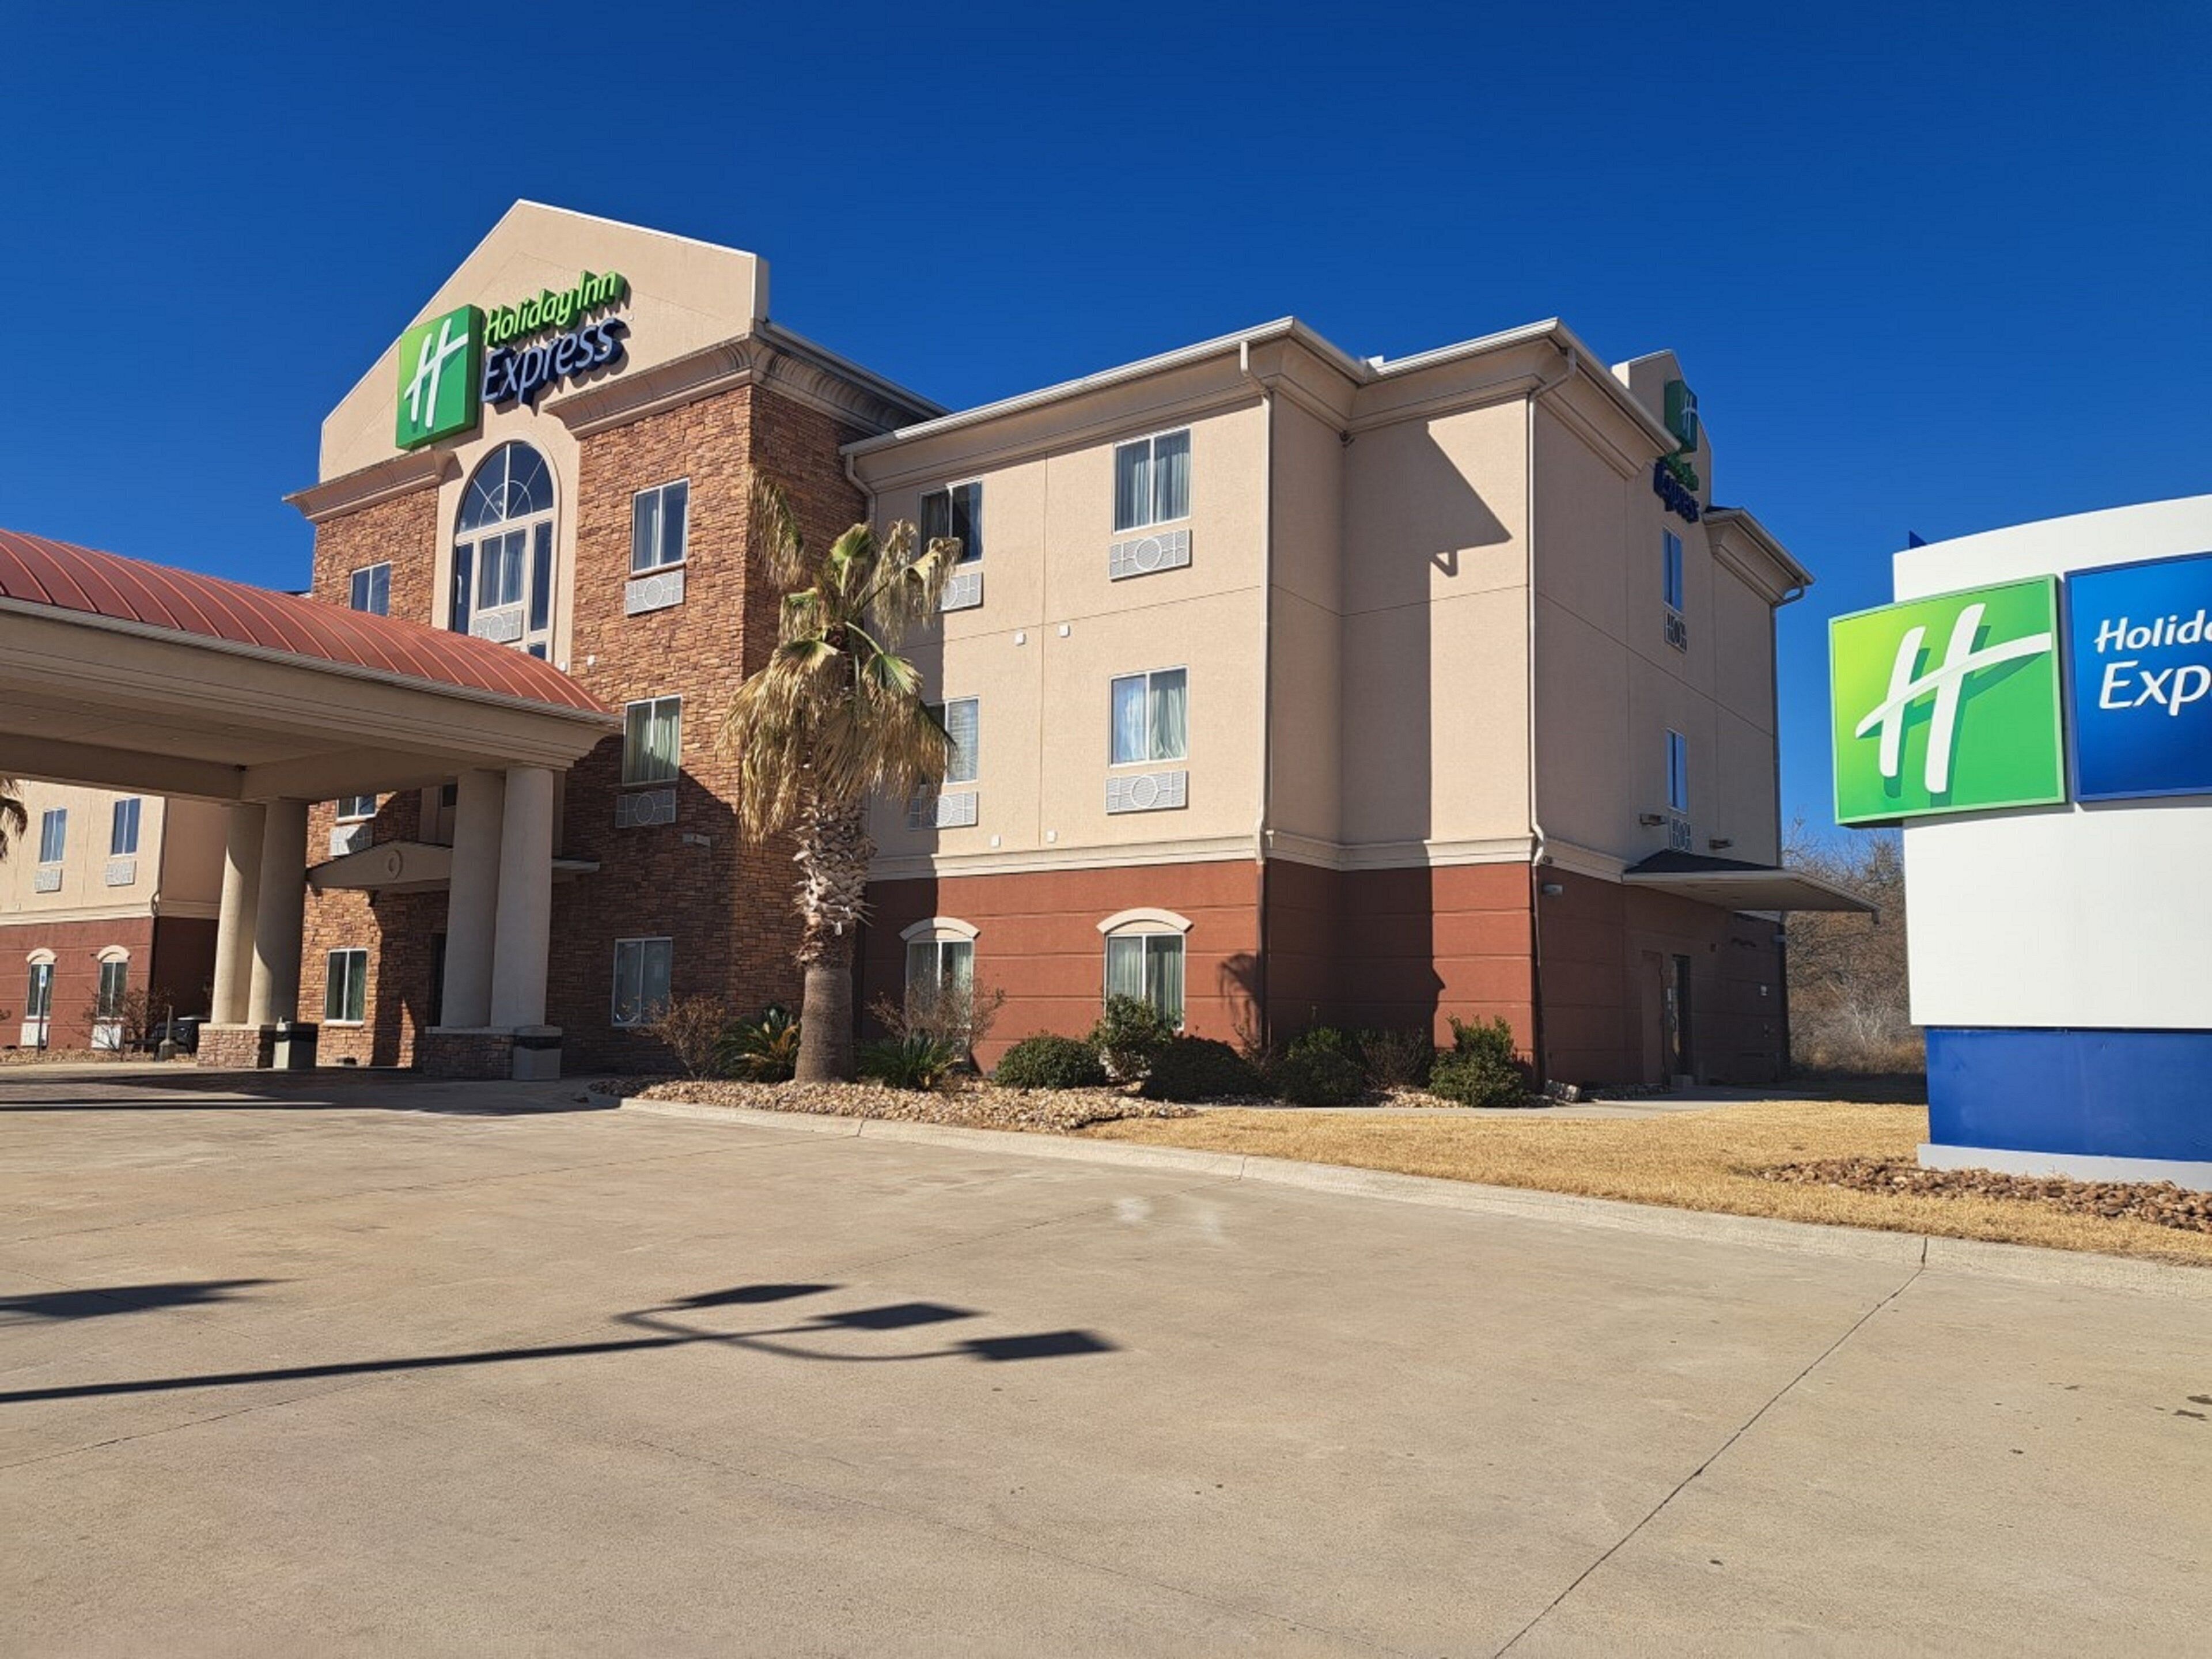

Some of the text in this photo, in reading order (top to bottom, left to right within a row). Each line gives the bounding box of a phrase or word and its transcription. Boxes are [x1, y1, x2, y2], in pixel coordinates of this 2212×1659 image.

[484, 270, 622, 346] Holiday Inn
[482, 318, 622, 404] Express
[2099, 660, 2212, 717] Exp
